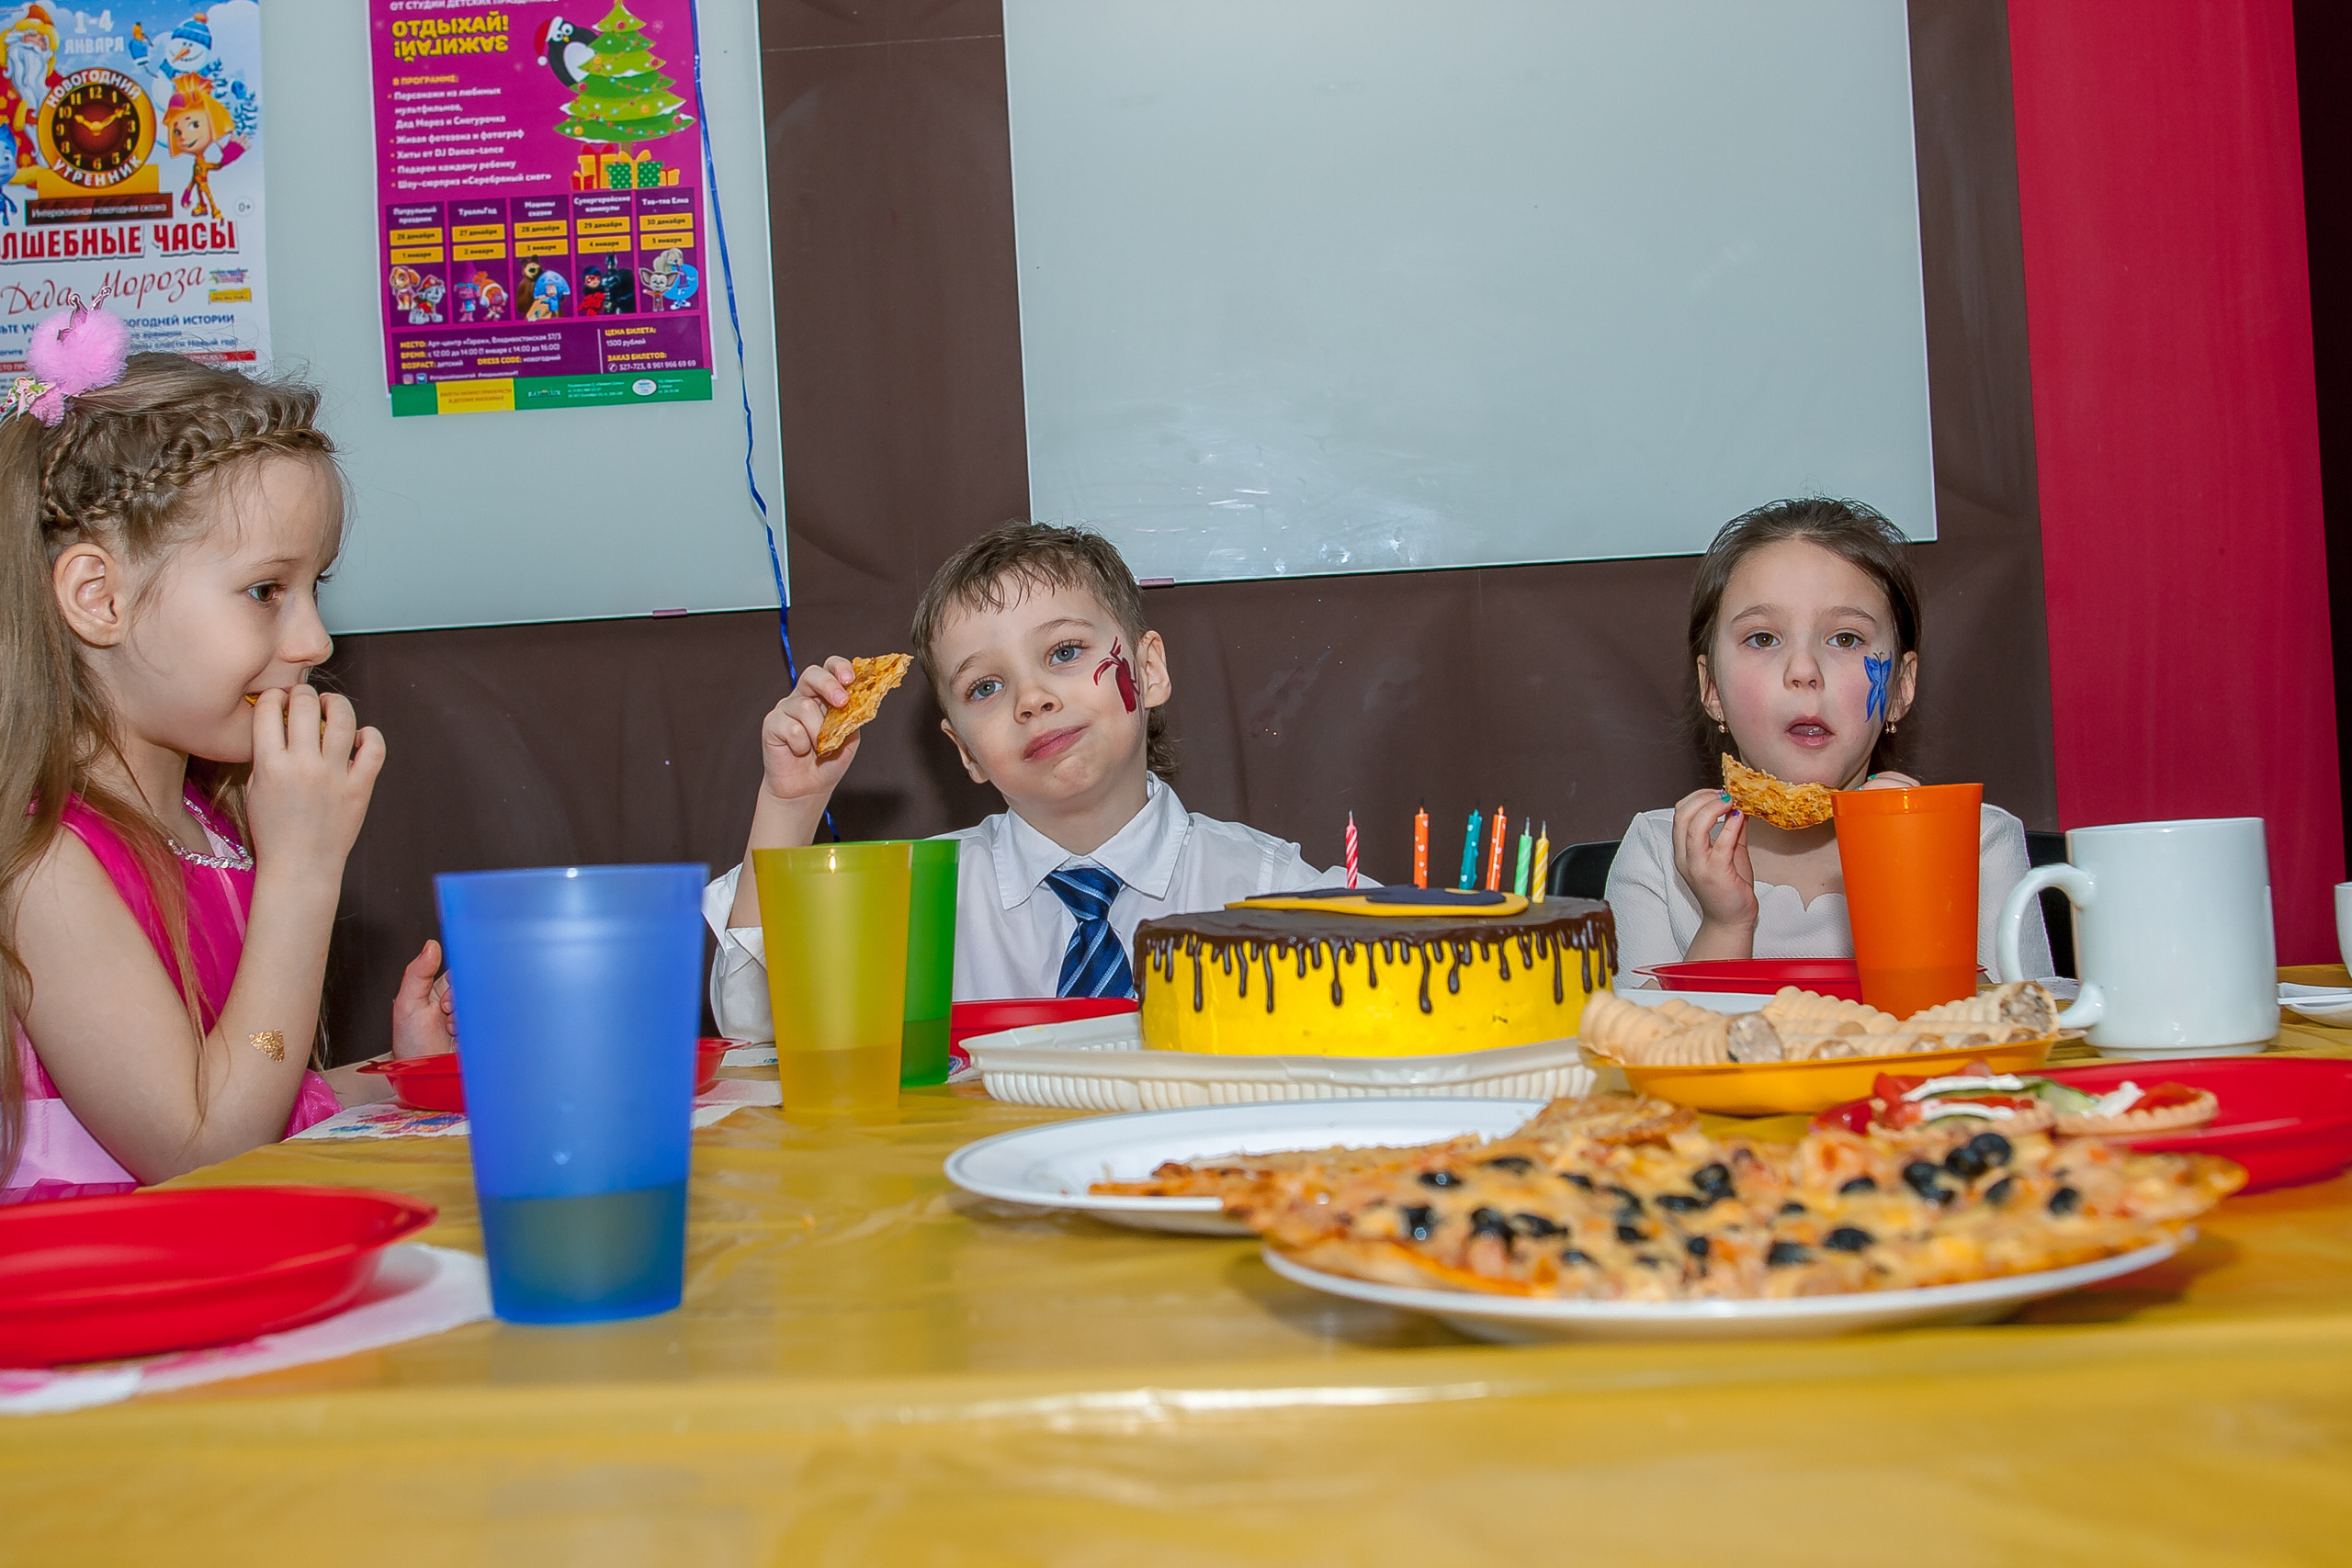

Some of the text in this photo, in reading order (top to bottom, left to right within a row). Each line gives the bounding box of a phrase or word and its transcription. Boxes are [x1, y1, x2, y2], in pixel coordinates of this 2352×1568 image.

[74, 9, 114, 34] 1-4
[391, 10, 508, 39] ОТДЫХАЙ!
[64, 37, 125, 54] ЯНВАРЯ
[46, 70, 141, 108] НОВОГОДНИЙ
[89, 86, 103, 99] 12
[71, 92, 82, 106] 11
[112, 91, 118, 103] 1
[59, 107, 73, 119] 10
[55, 125, 64, 137] 9
[127, 120, 136, 132] 3
[61, 141, 71, 153] 8
[434, 147, 447, 158] DJ
[74, 154, 82, 166] 7
[94, 158, 103, 171] 6
[112, 152, 120, 165] 5
[52, 155, 142, 186] УТРЕННИК
[153, 221, 236, 253] ЧАСЫ
[1, 266, 206, 315] Деда Мороза
[123, 314, 235, 327] ОГОДНЕЙ ИСТОРИИ
